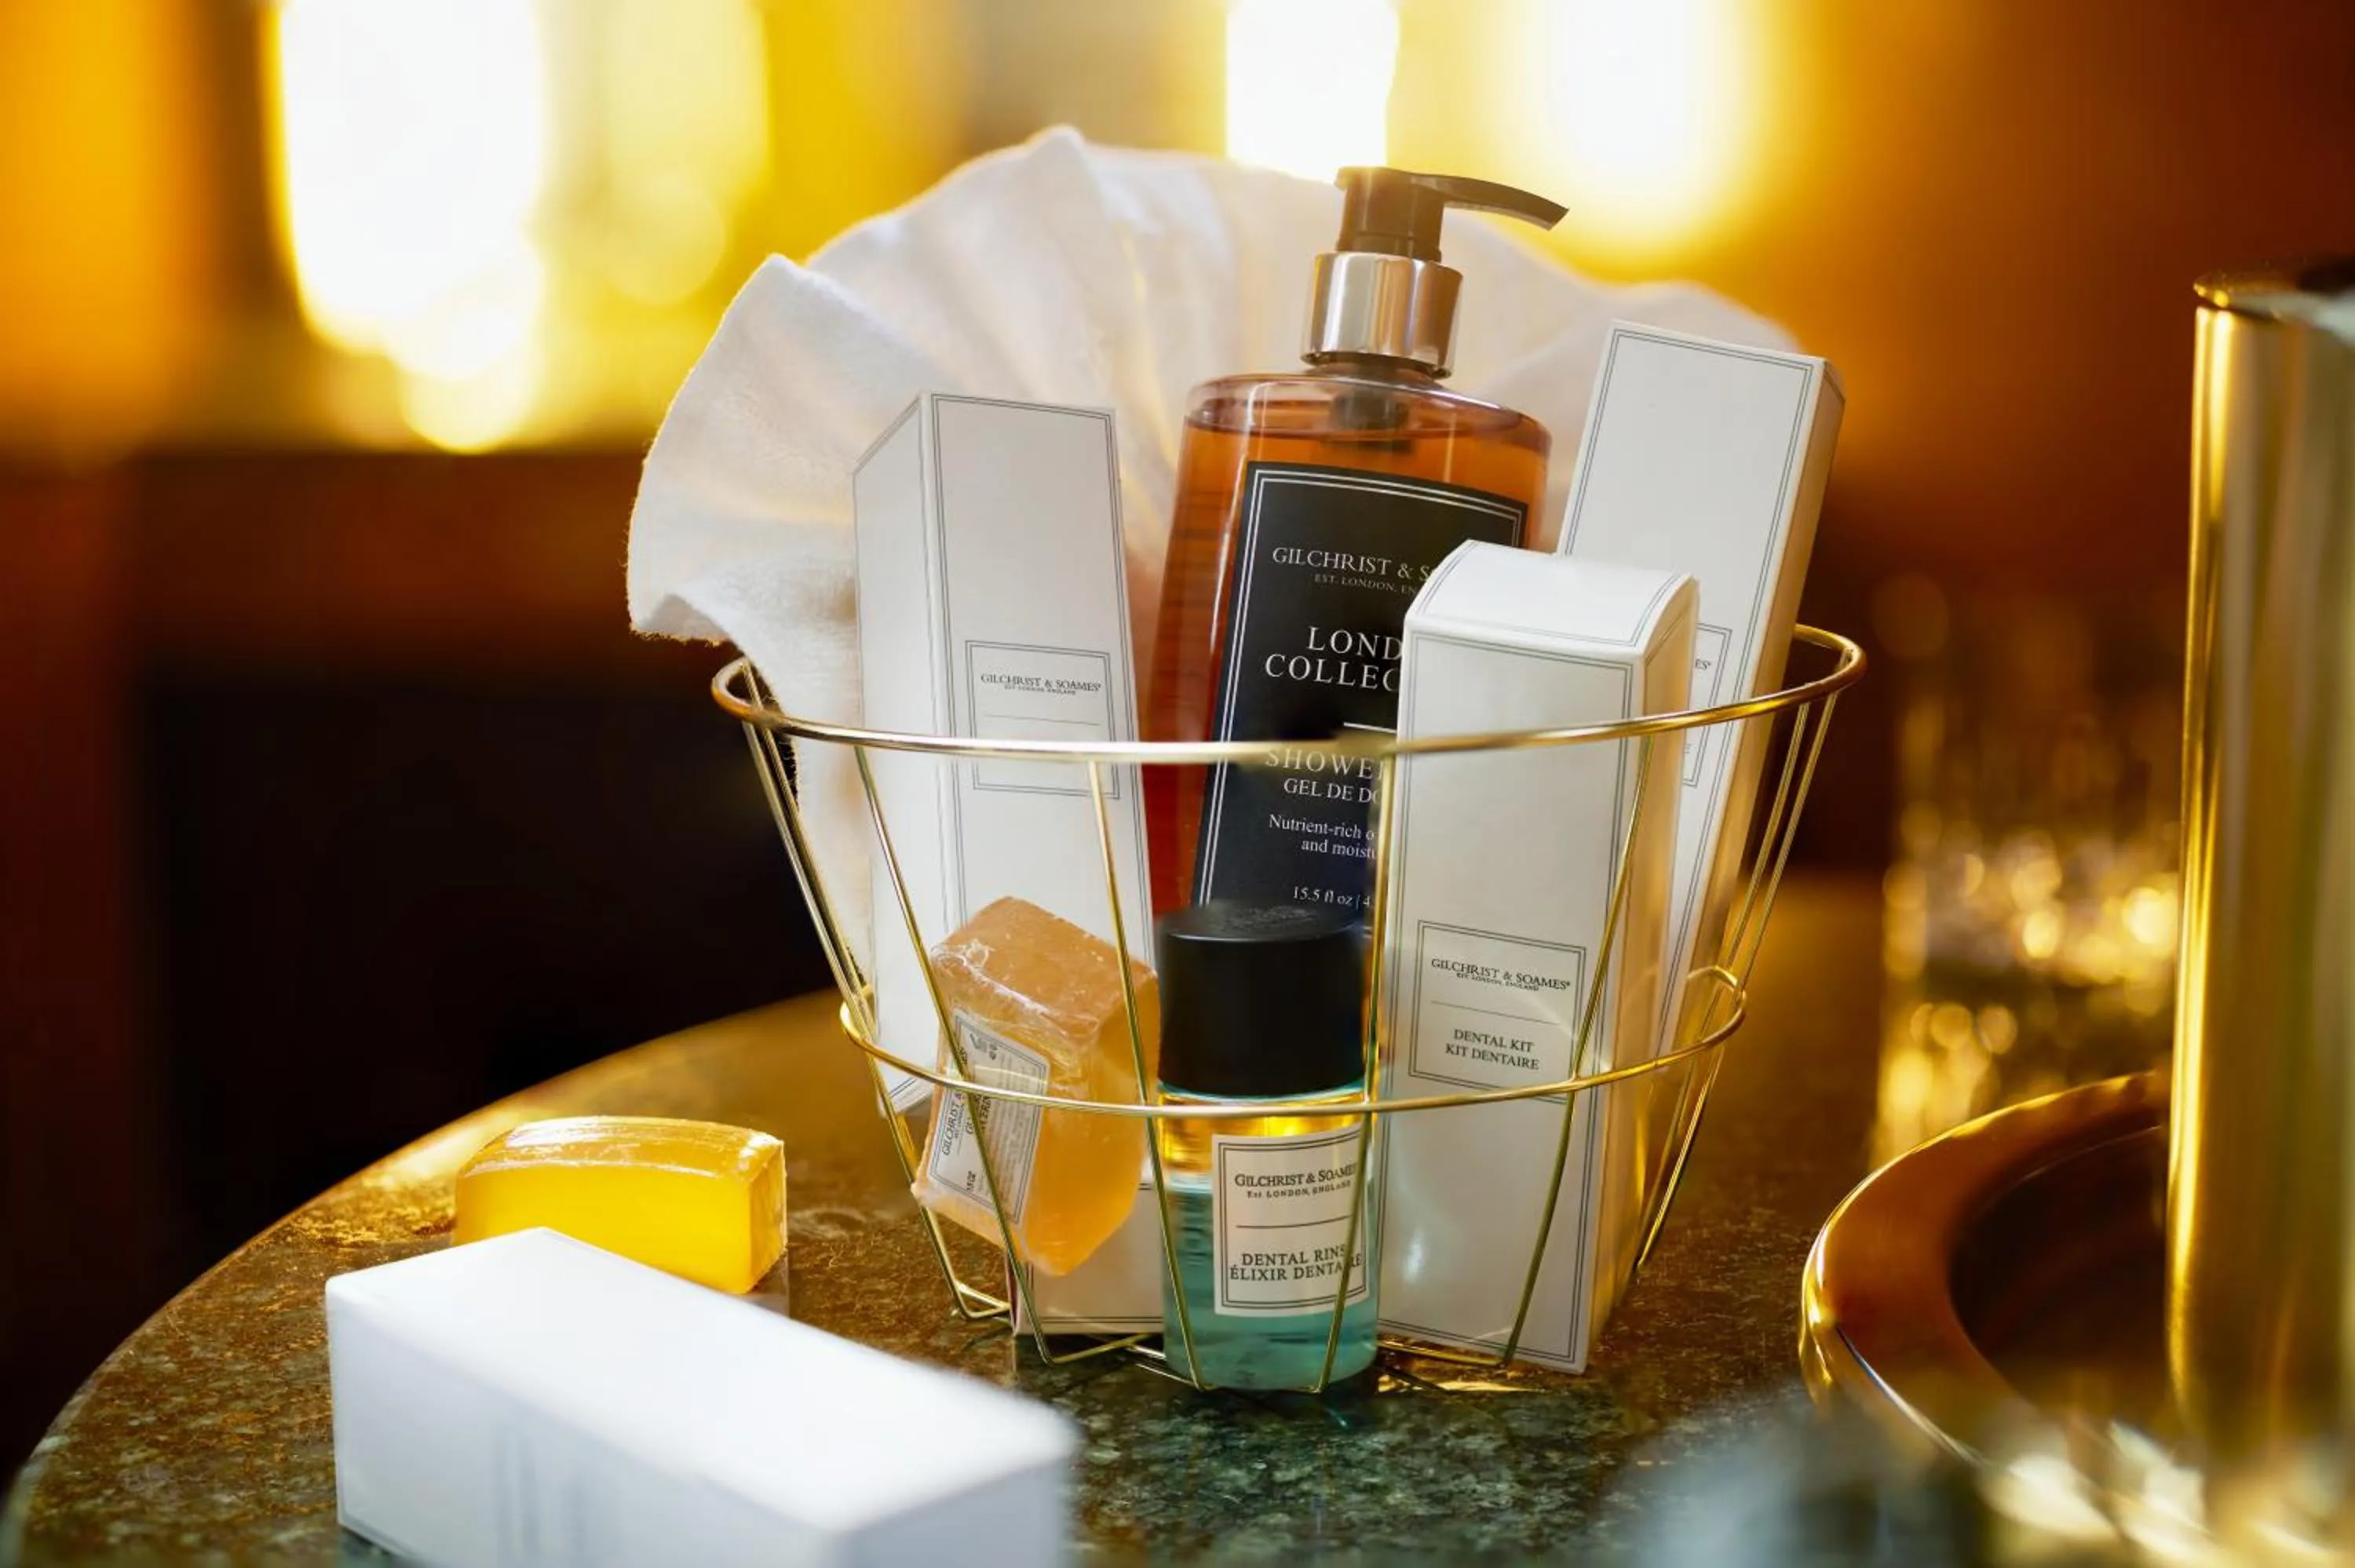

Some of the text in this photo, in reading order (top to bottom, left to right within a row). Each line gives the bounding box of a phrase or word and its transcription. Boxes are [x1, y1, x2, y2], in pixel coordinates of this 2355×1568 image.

[1272, 547, 1391, 575] GILCHRIST
[1397, 563, 1412, 578] &
[980, 673, 1042, 687] GILCHRIST
[1283, 778, 1322, 797] GEL
[1327, 782, 1354, 801] DE
[1269, 814, 1362, 840] Nutrient-rich
[1301, 838, 1328, 854] and
[1293, 886, 1320, 903] 15.5
[1324, 889, 1334, 903] fl
[1337, 895, 1353, 906] oz
[1431, 957, 1500, 979] GILCHRIST
[1502, 970, 1513, 981] &
[1453, 1028, 1535, 1053] DENTAL KIT
[1445, 1043, 1540, 1070] KIT DENTAIRE
[1234, 1172, 1306, 1188] GILCHRIST
[1306, 1172, 1316, 1183] &
[1242, 1243, 1345, 1267] DENTAL RINS
[1229, 1264, 1288, 1282] ÉLIXIR
